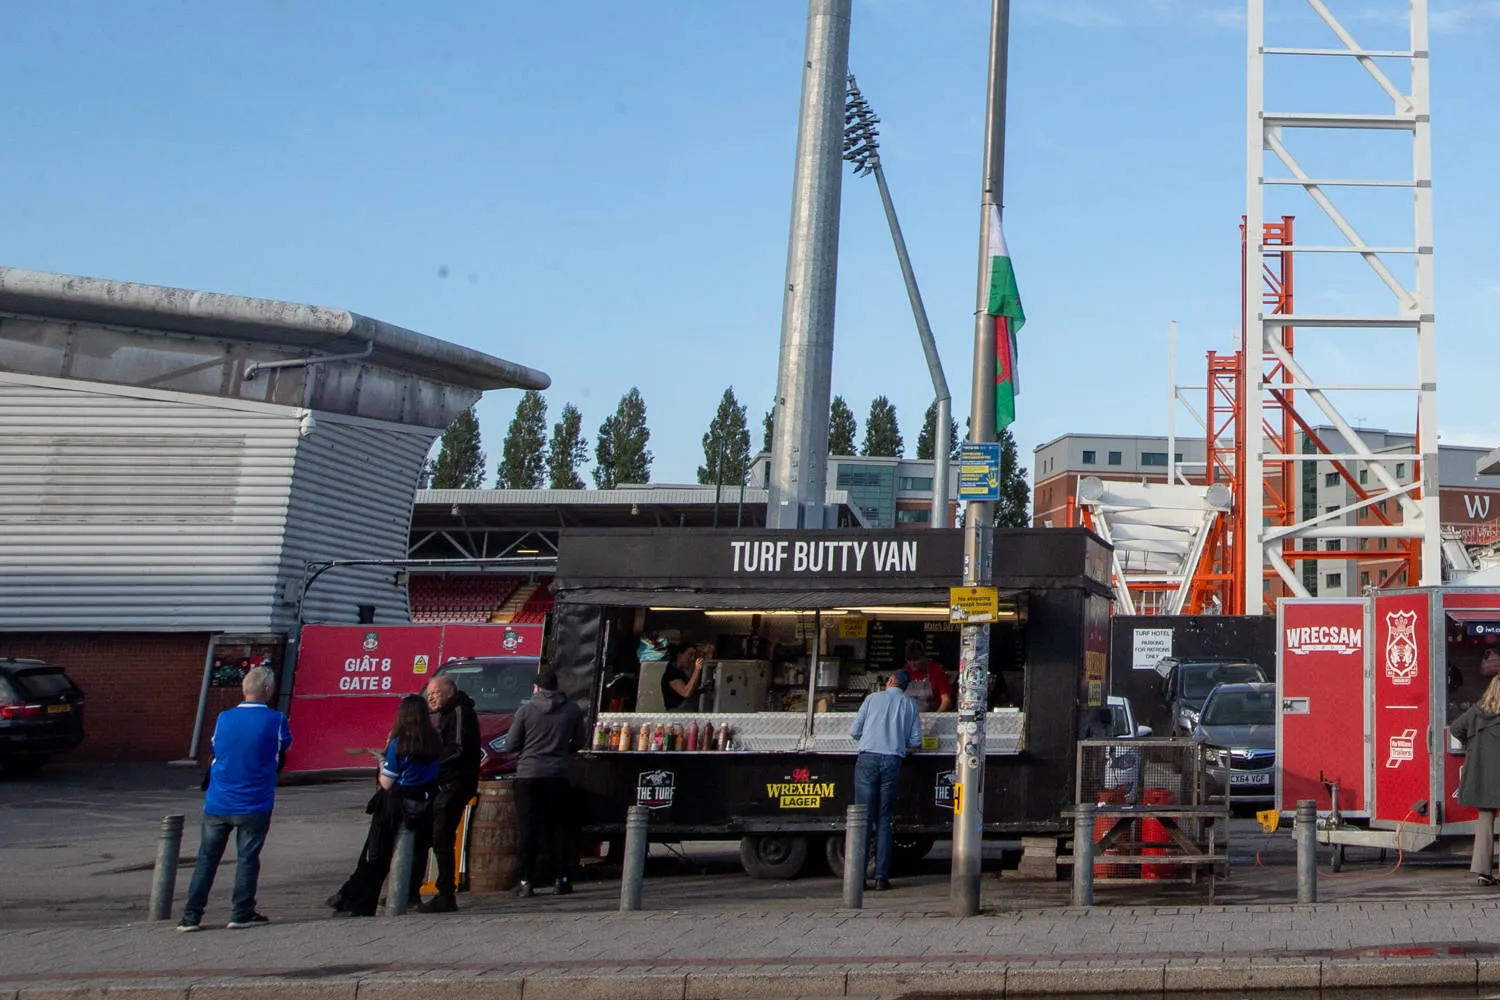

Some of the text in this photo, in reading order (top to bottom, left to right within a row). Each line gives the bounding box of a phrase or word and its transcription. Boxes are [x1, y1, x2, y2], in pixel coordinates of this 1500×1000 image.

[1463, 494, 1490, 519] W
[730, 541, 917, 572] TURF BUTTY VAN
[1286, 626, 1362, 648] WRECSAM
[344, 655, 392, 672] GIÂT 8
[339, 676, 392, 690] GATE 8
[637, 786, 676, 800] THE TURF
[766, 783, 835, 798] WREXHAM
[934, 786, 950, 799] THE
[783, 797, 818, 806] LAGER
